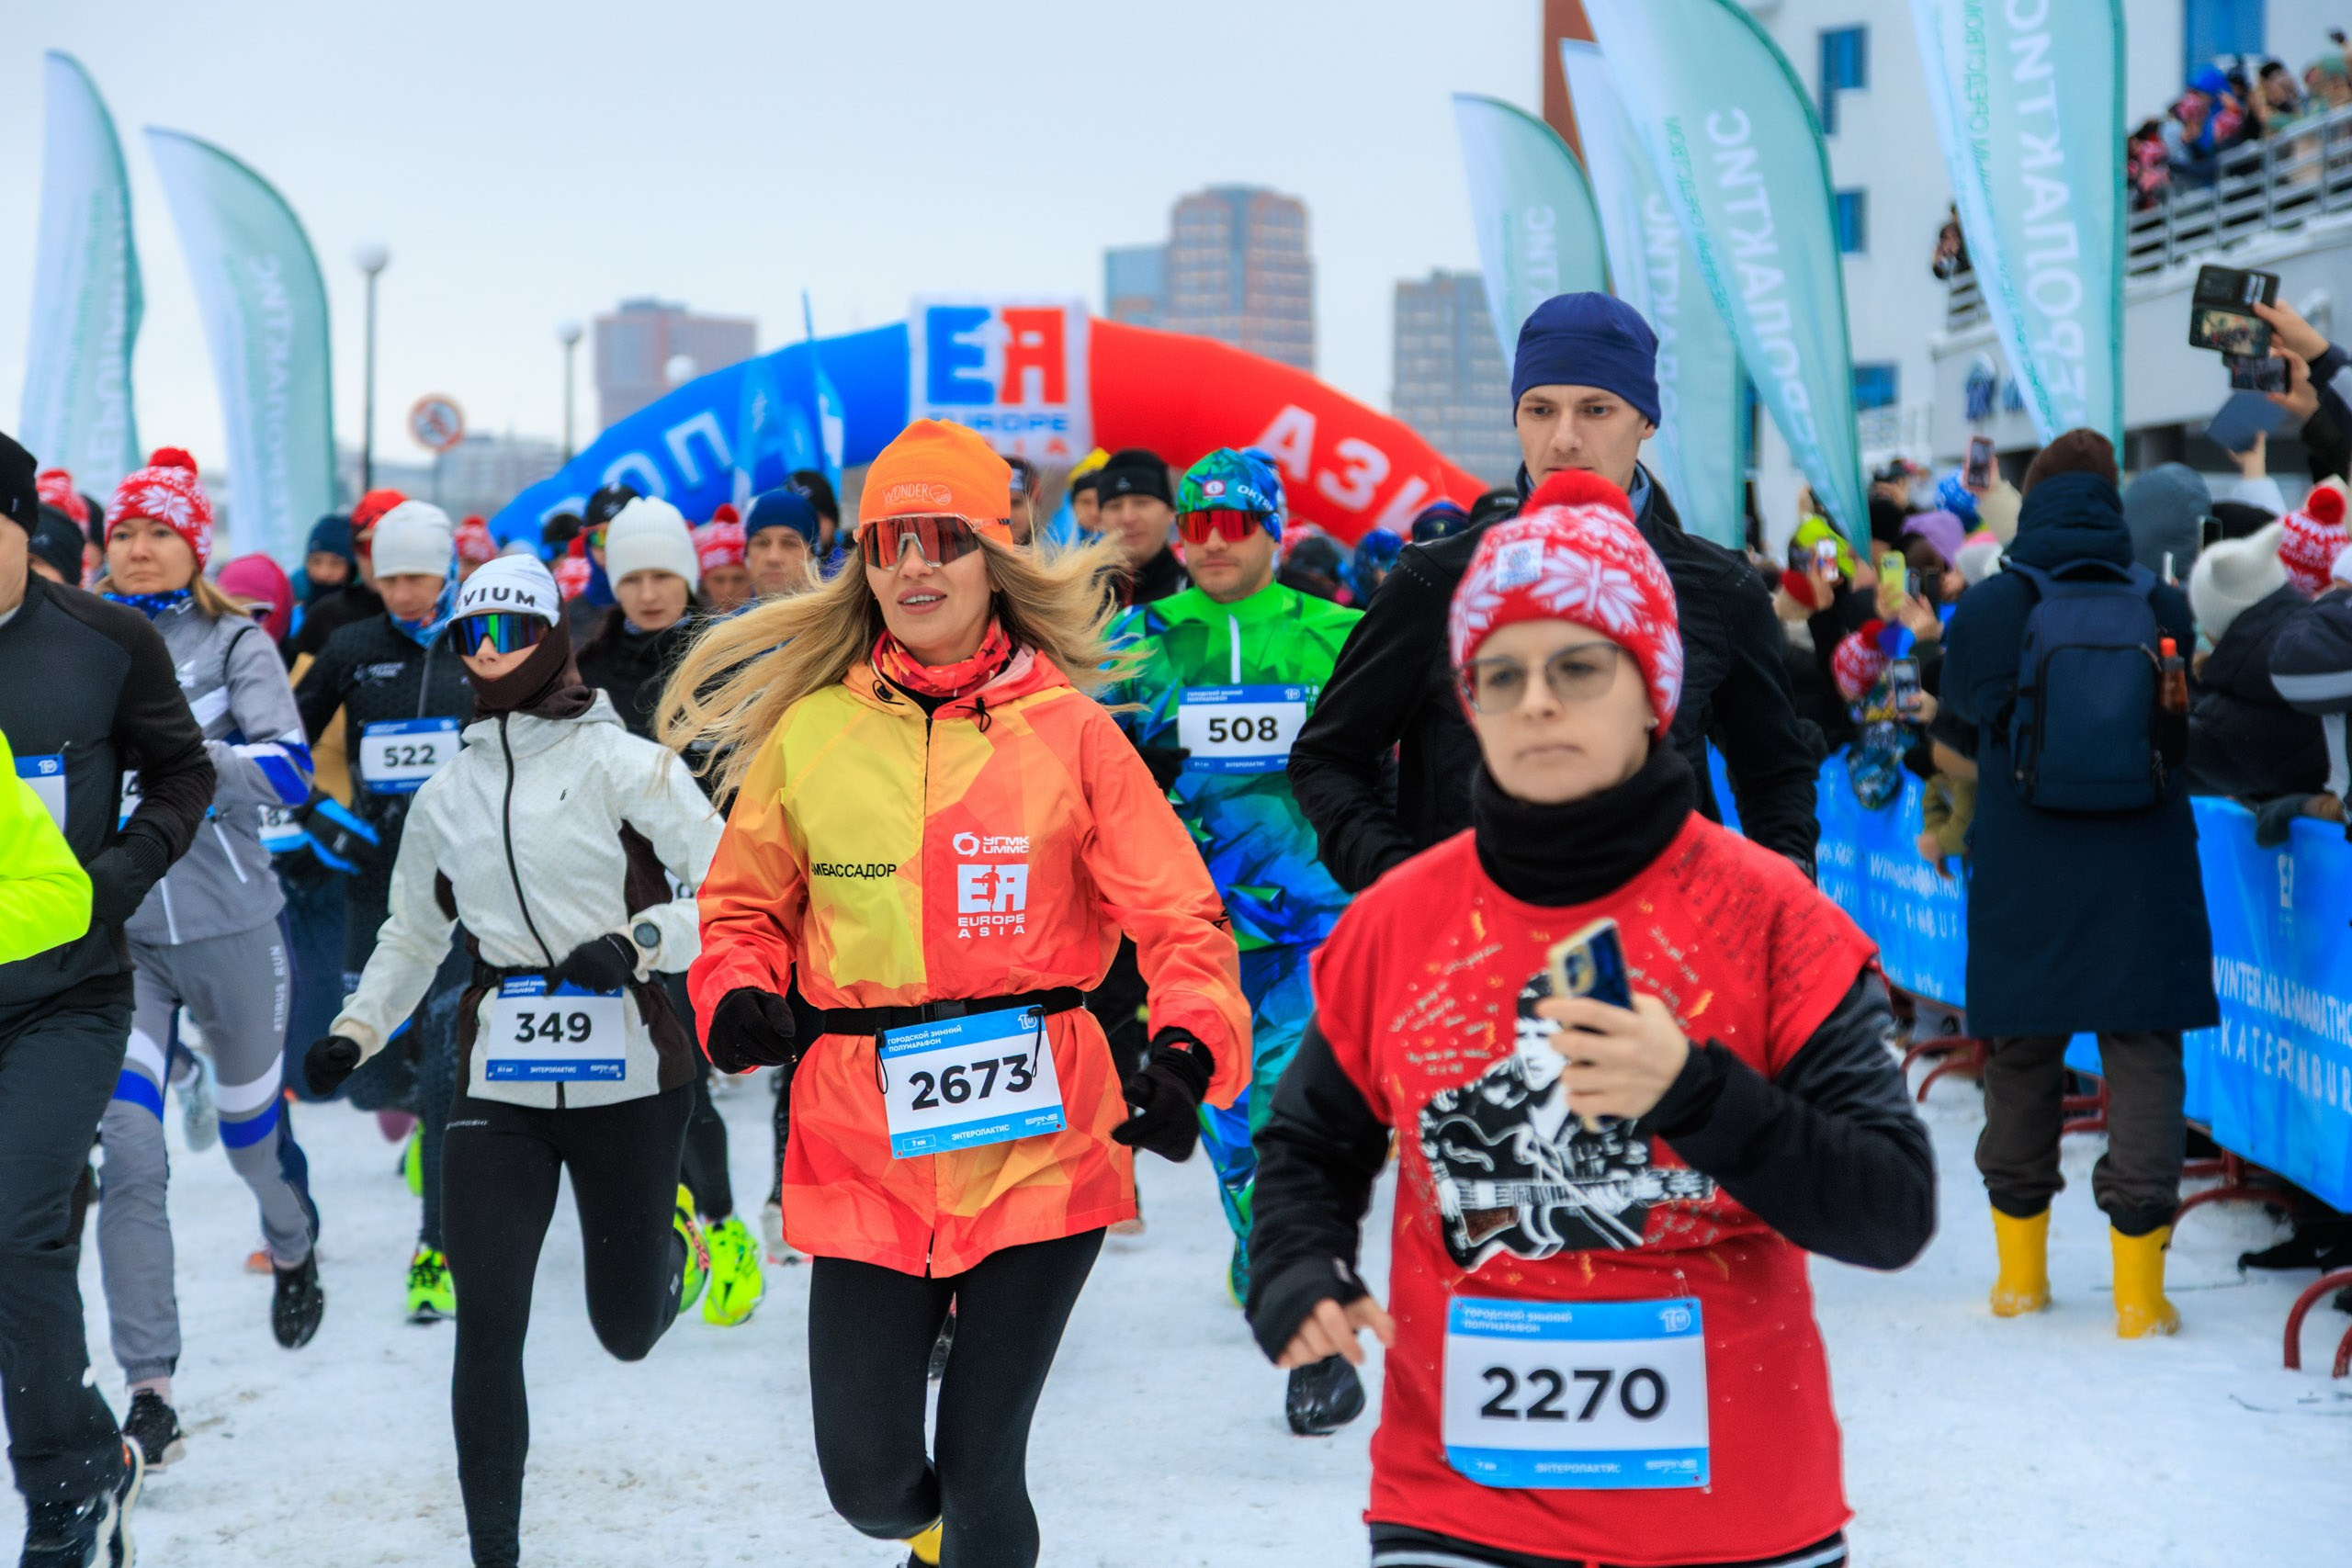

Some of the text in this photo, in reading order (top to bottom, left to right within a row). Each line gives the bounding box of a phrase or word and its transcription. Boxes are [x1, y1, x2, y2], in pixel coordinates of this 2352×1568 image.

[927, 307, 1067, 405] EA
[928, 413, 1069, 432] ROPE
[882, 483, 929, 503] WONDER
[458, 587, 536, 609] VIUM
[1208, 716, 1279, 743] 508
[383, 744, 436, 768] 522
[983, 836, 1030, 845] УГМК
[983, 845, 1030, 854] UMMC
[957, 864, 1029, 914] EA
[958, 913, 1025, 927] EUROPE
[957, 925, 1025, 939] ASIA
[268, 944, 287, 977] RUN
[514, 1011, 593, 1044] 349
[888, 1024, 963, 1045] ГОРОДСКОЙ ЗИМНИЙ
[888, 1037, 942, 1054] ПОЛУМАРАФОН
[908, 1053, 1034, 1111] 2673
[951, 1123, 1011, 1141] ЭНТЕРОЛАКТИС
[1479, 1366, 1668, 1423] 2270
[1533, 1462, 1623, 1474] ЭНТЕРОЛАКТИС
